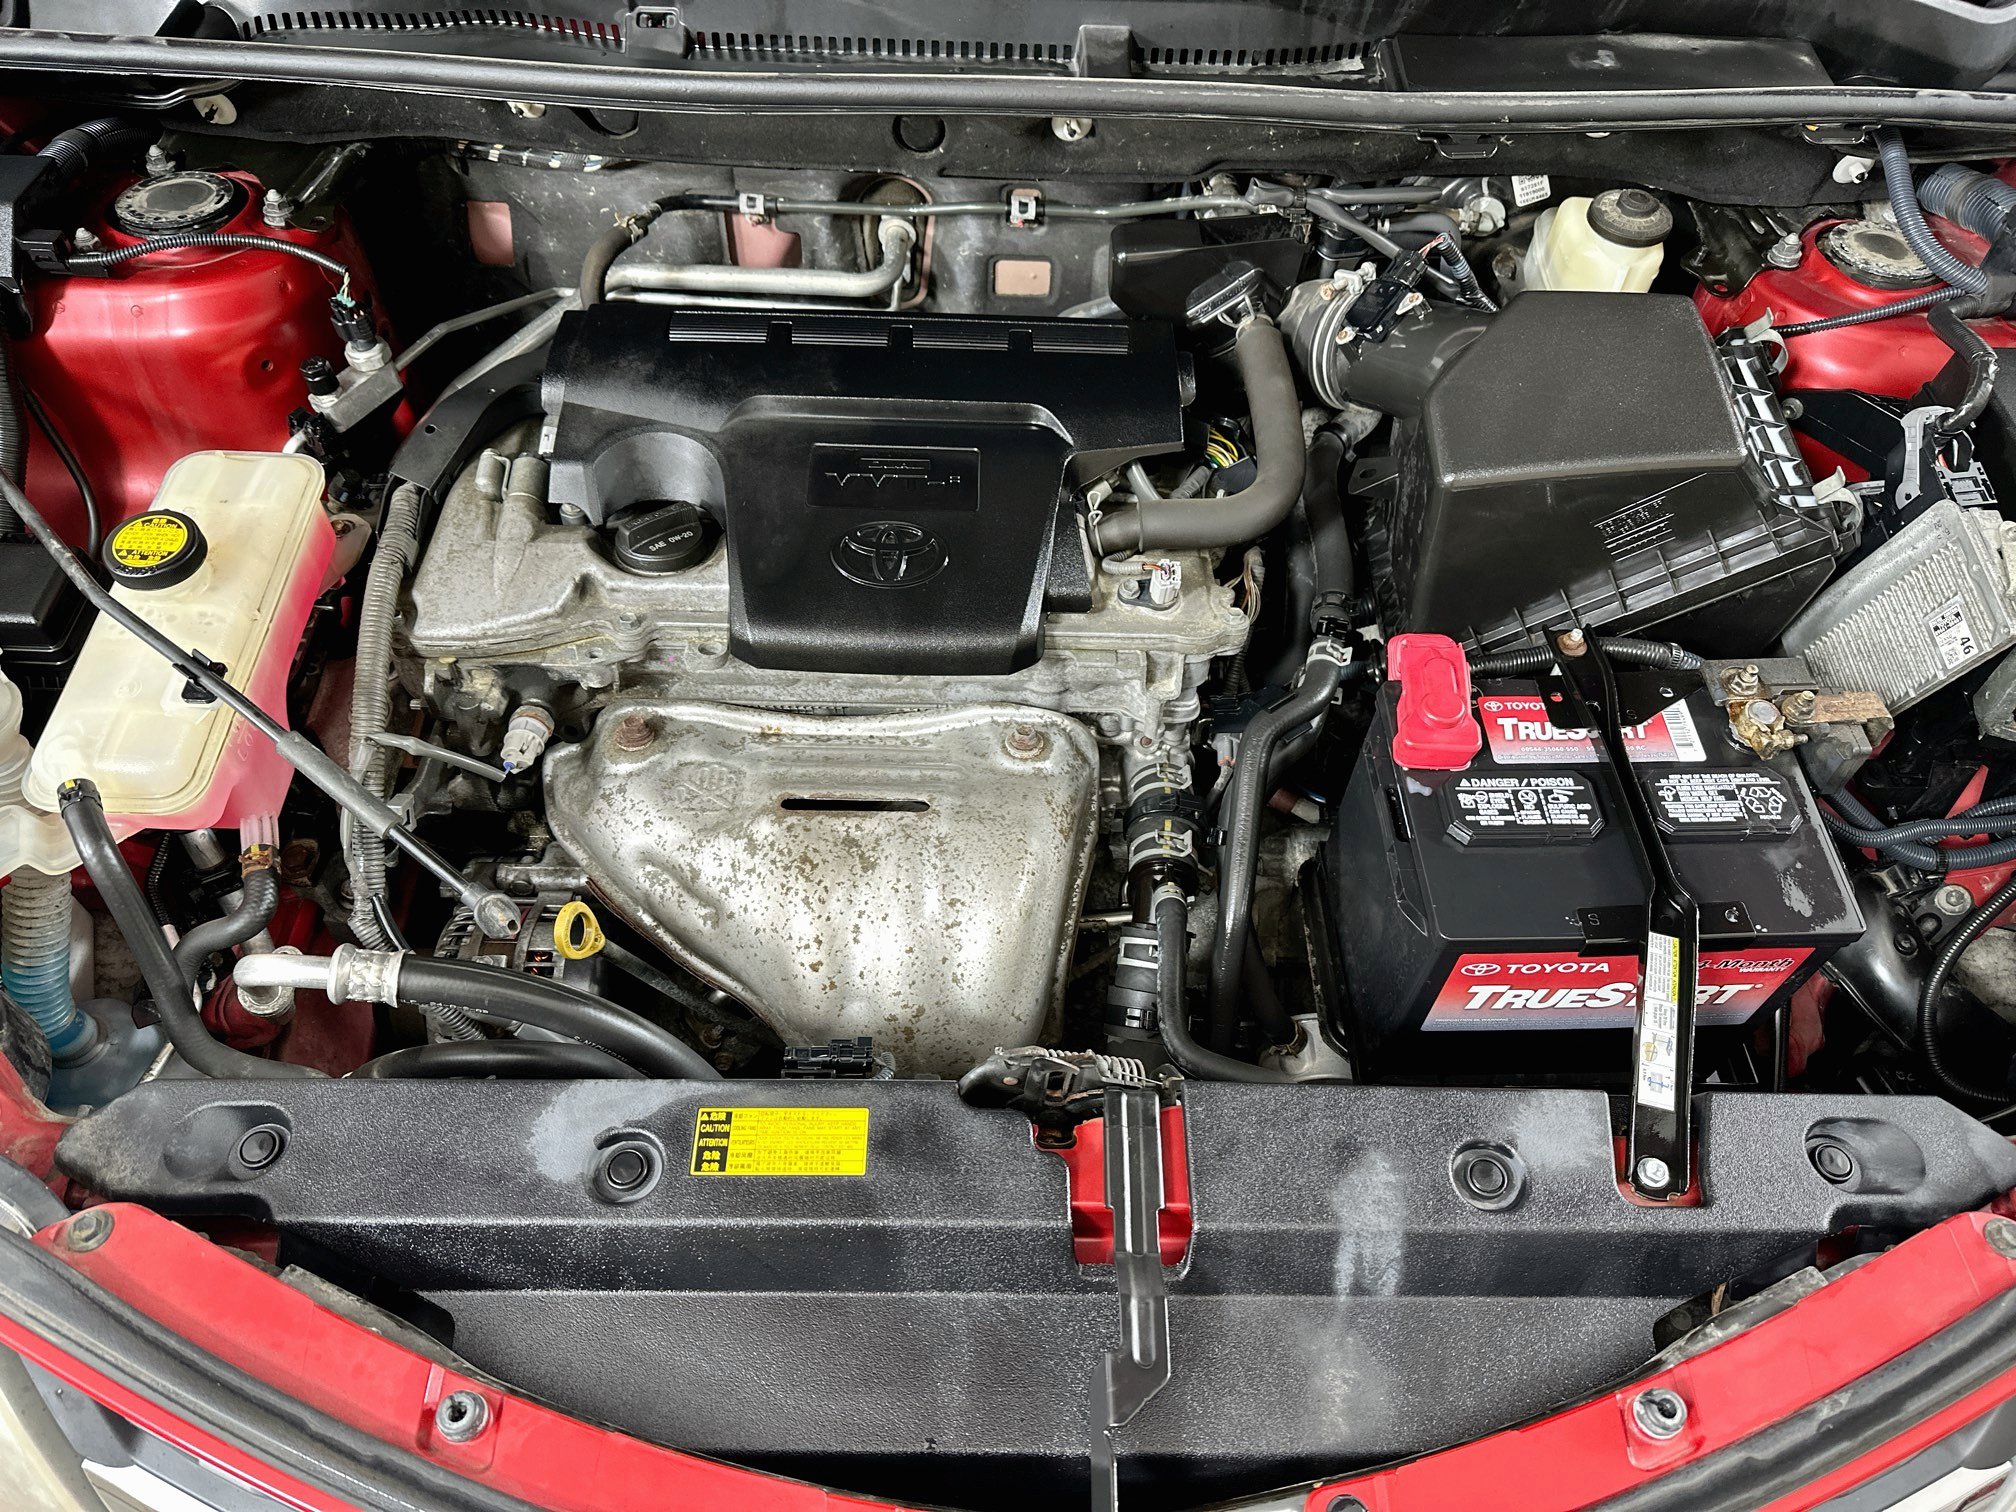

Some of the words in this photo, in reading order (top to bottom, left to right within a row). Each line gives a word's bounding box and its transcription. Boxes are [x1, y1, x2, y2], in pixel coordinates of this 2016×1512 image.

[649, 541, 667, 552] SAE
[668, 530, 694, 543] 0W-20
[132, 549, 168, 557] ATTENTION
[1960, 636, 1975, 655] 46
[1504, 701, 1547, 711] TOYOT
[1470, 778, 1519, 787] DANGER
[1521, 778, 1528, 787] /
[1530, 777, 1574, 787] POISON
[1506, 962, 1610, 974] TOYOTA
[1713, 957, 1795, 969] Month
[700, 1123, 730, 1133] CAUTION
[698, 1138, 728, 1147] ATTENTION
